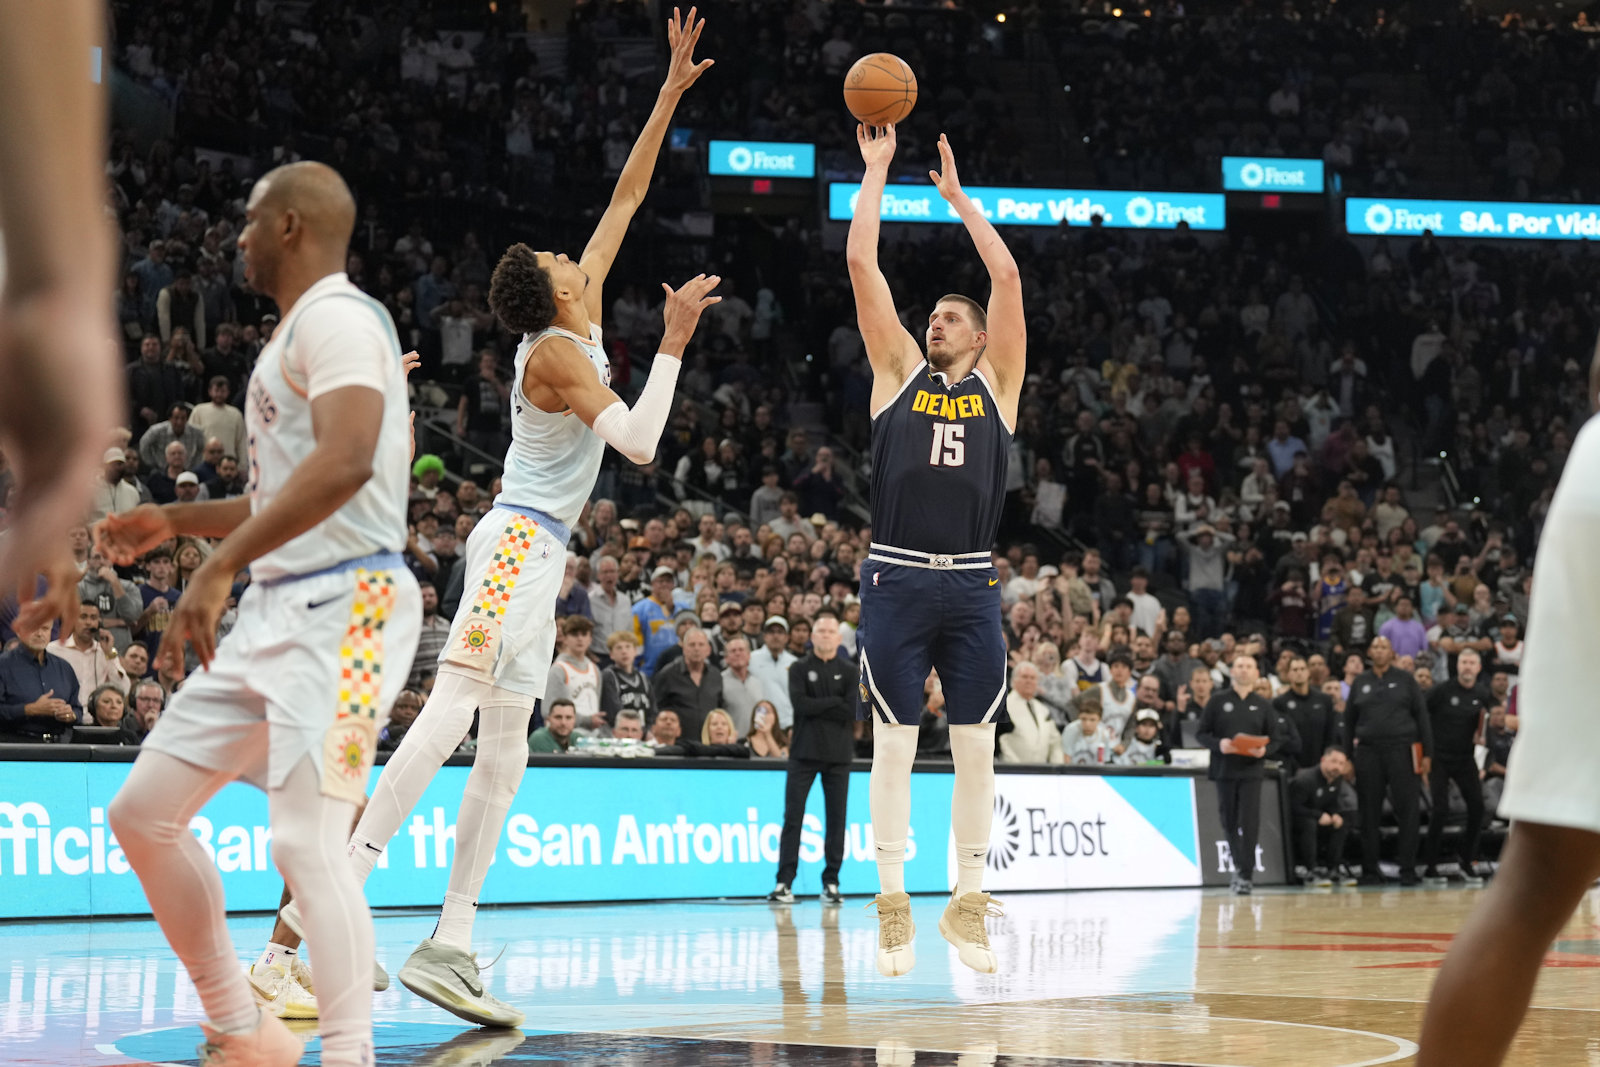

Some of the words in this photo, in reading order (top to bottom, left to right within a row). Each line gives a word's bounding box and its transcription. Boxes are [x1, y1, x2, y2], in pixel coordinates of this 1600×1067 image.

[753, 151, 795, 170] Frost
[1265, 167, 1305, 185] Frost
[880, 194, 931, 217] Frost
[997, 197, 1044, 220] Por
[1156, 202, 1205, 224] Frost
[1395, 208, 1443, 231] Frost
[1459, 210, 1503, 233] SA.
[1507, 212, 1552, 234] Por
[929, 422, 965, 467] 15
[187, 815, 273, 873] Ban
[506, 813, 602, 867] San
[611, 806, 782, 865] Antonio
[1026, 808, 1109, 857] Frost
